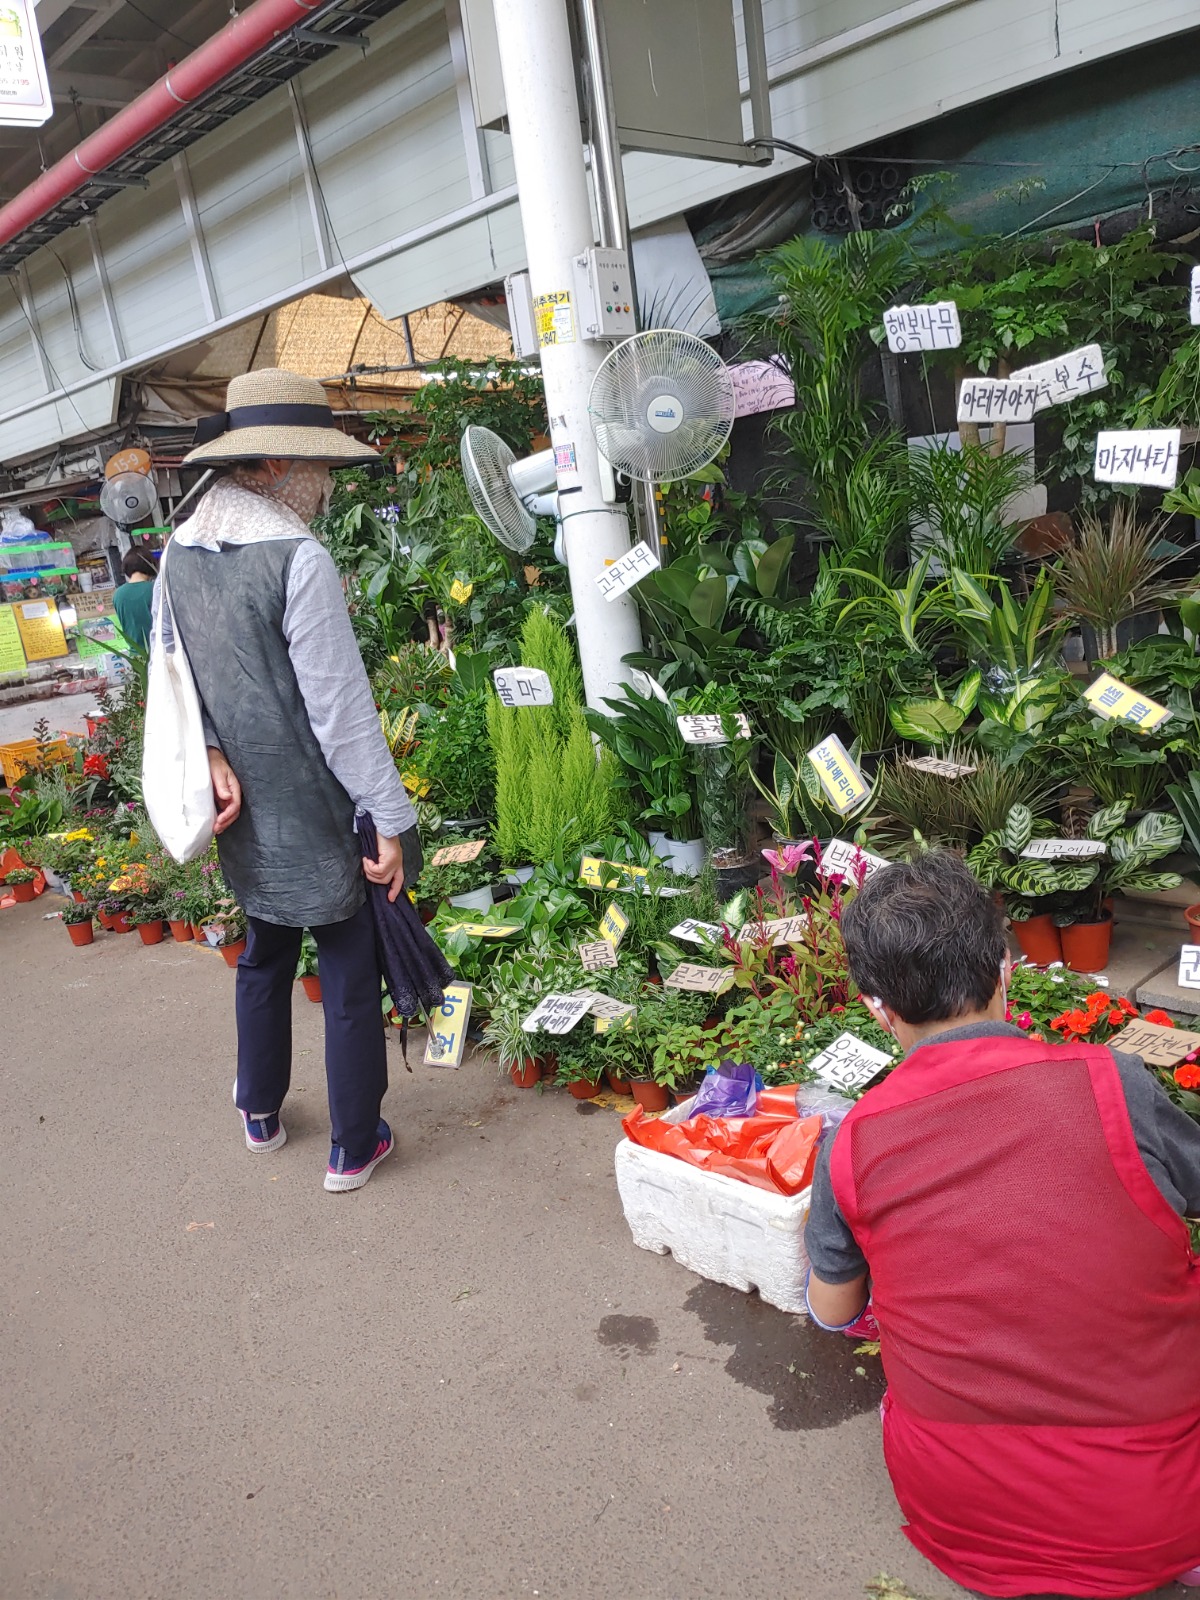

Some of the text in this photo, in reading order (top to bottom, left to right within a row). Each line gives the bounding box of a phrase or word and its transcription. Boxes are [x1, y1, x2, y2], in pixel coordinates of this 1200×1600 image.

[886, 308, 954, 351] 행복나무
[963, 385, 1039, 417] 아레카야자
[1099, 441, 1179, 475] 마지나타
[597, 547, 650, 597] 고무나무
[817, 747, 856, 803] 산세베리아
